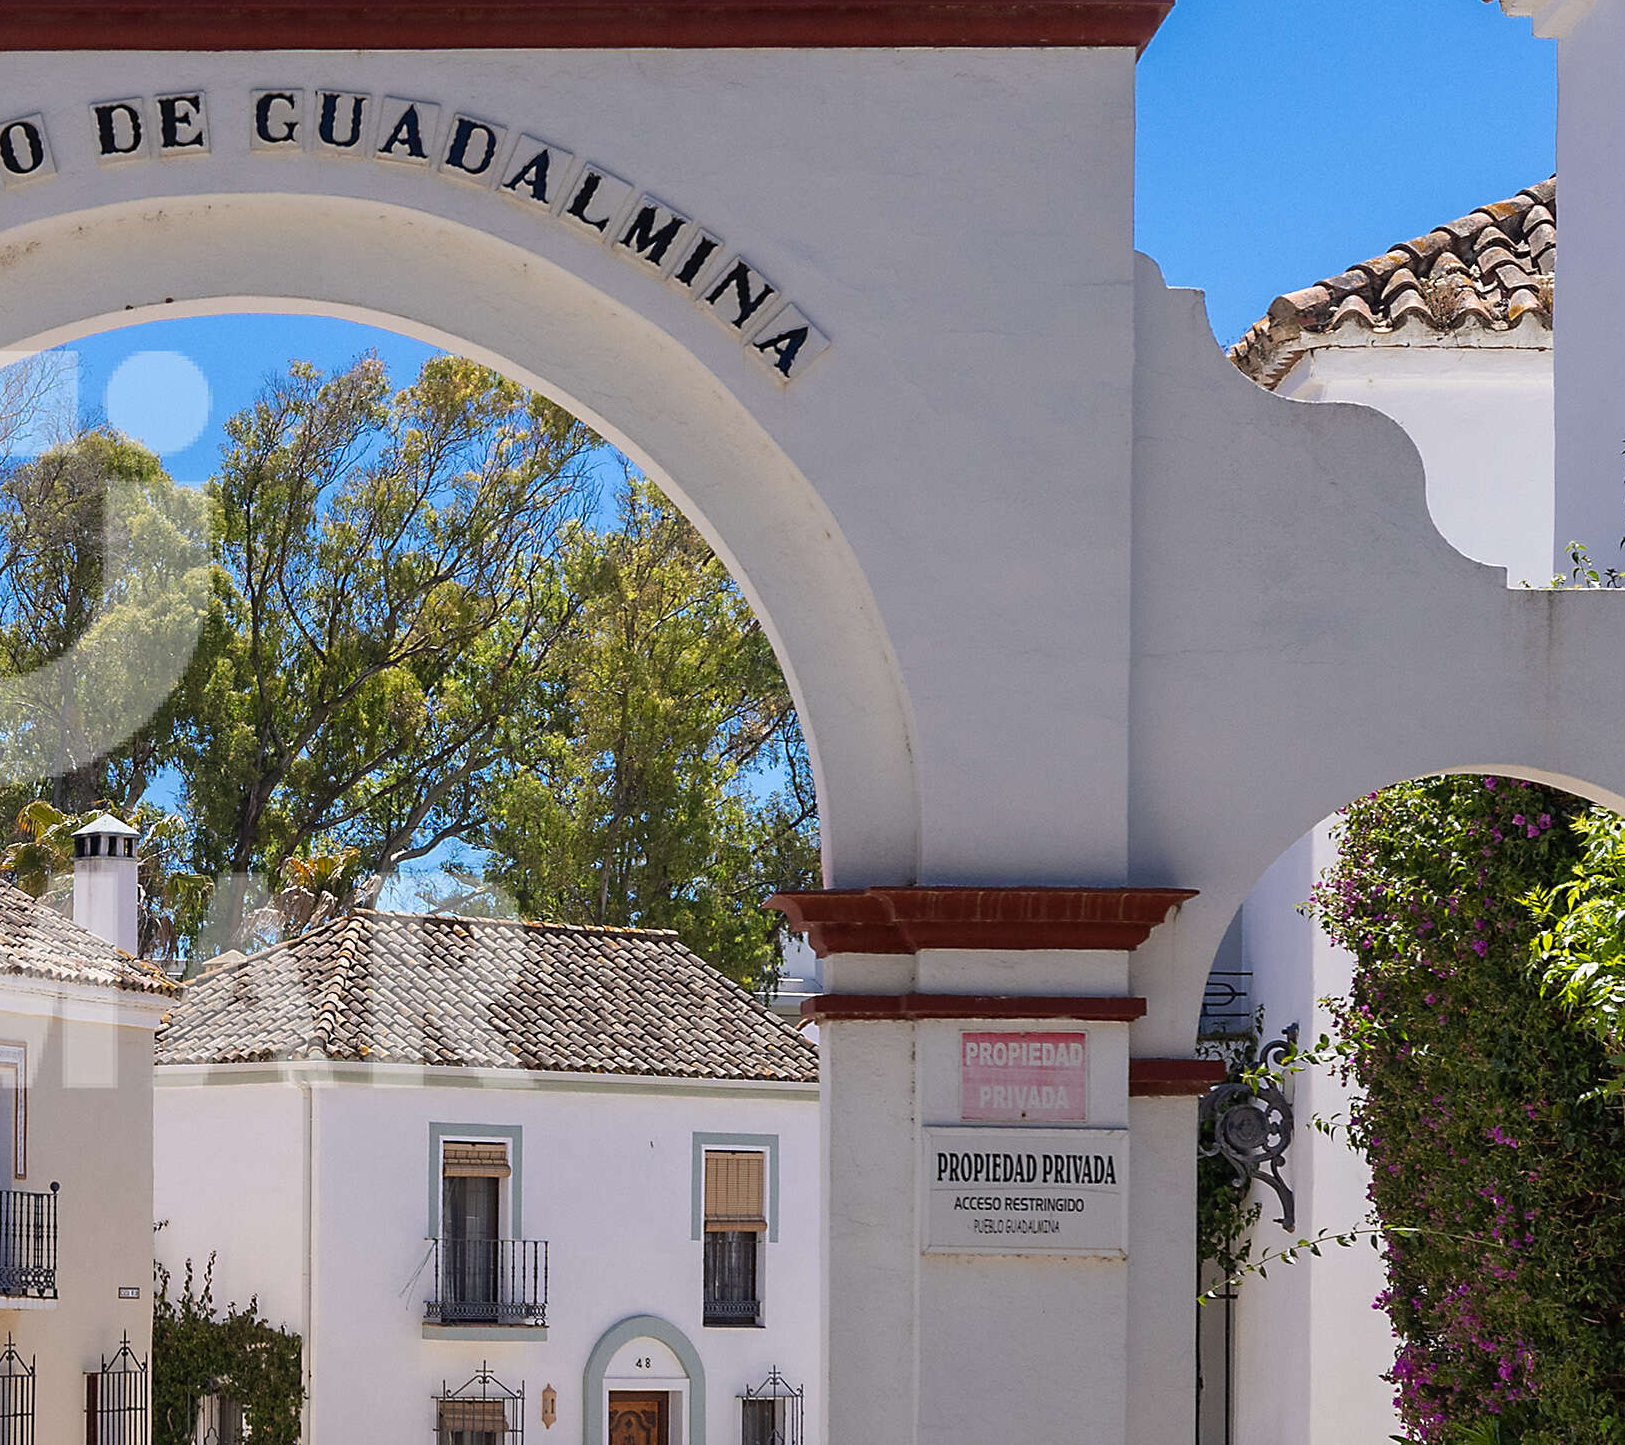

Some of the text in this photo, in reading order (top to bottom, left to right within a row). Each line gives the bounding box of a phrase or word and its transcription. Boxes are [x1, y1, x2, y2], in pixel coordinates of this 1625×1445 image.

[94, 94, 204, 155] DE
[254, 92, 809, 378] GUADALMINA
[965, 1042, 1084, 1066] PROPIEDAD
[979, 1085, 1070, 1108] PRIVADA
[937, 1152, 1117, 1185] PROPIEDAD PRIVADA
[953, 1196, 1085, 1213] ACCESO RESTRINGIDO
[635, 1357, 651, 1369] 48
